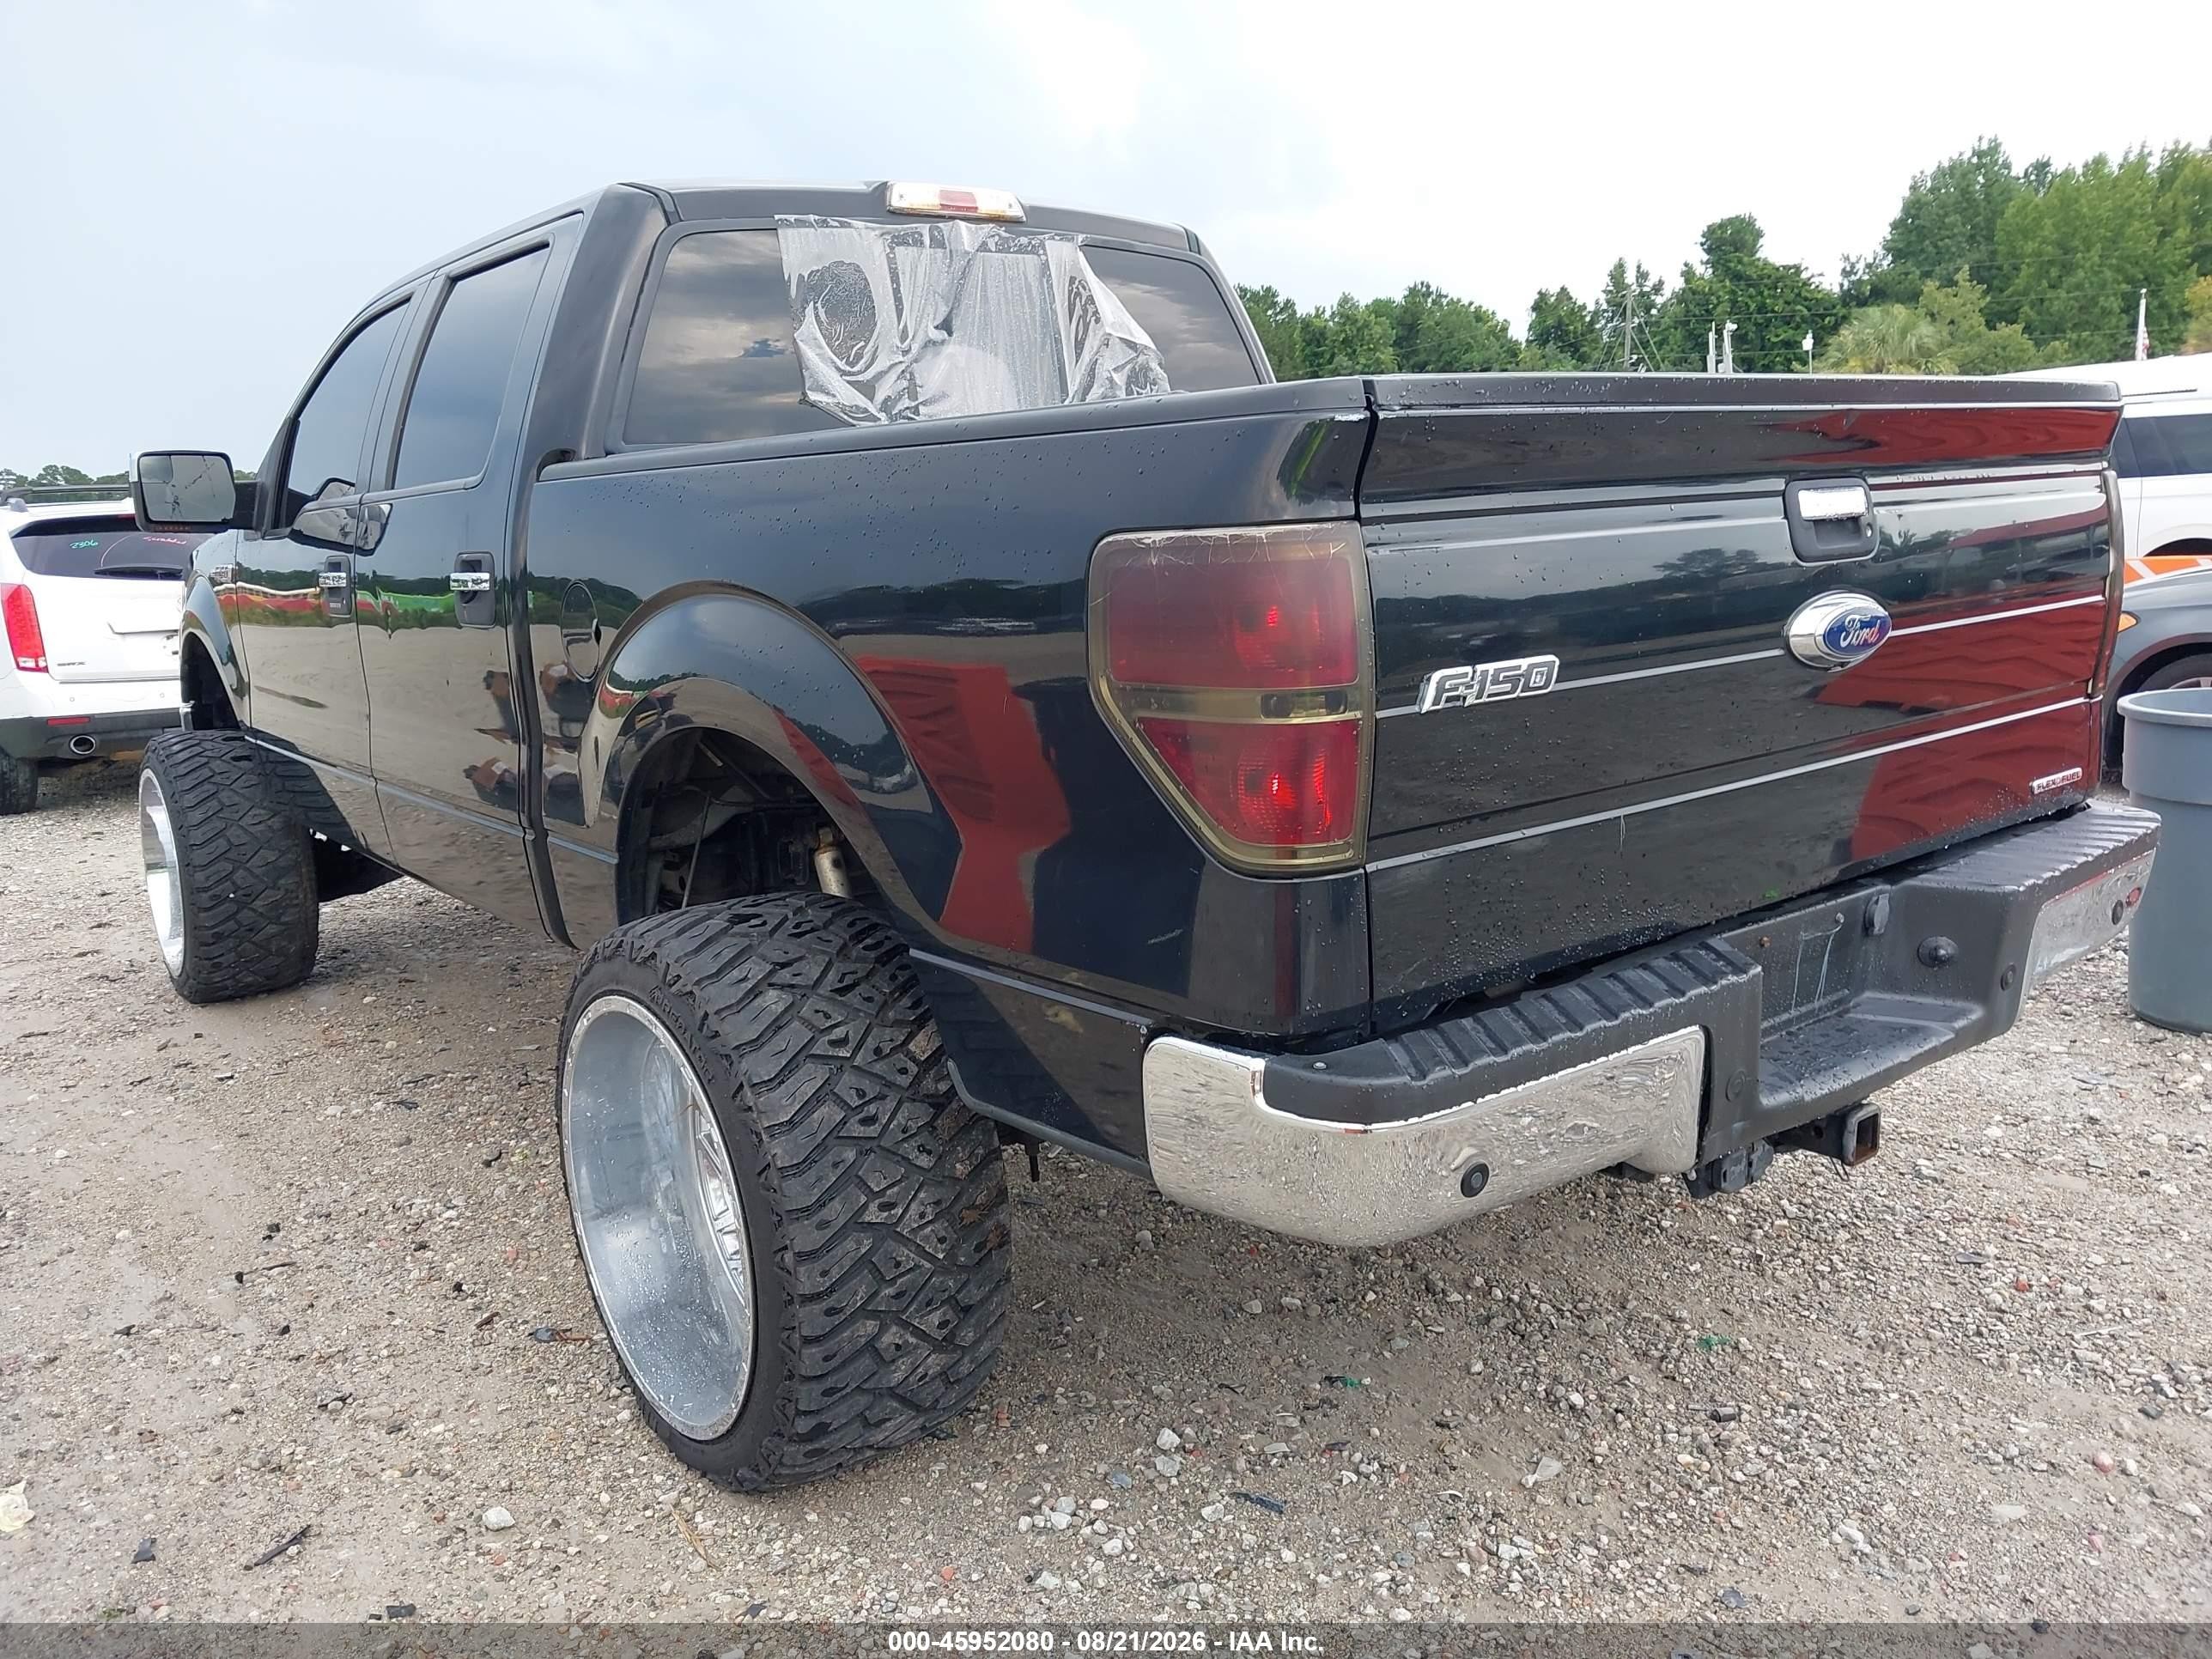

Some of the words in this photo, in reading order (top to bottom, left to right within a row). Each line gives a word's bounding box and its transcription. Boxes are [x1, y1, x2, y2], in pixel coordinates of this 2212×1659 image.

[69, 539, 99, 549] 2306
[1839, 614, 1881, 648] Ford
[1419, 655, 1560, 714] F-150
[2036, 776, 2057, 792] FLEX
[2062, 771, 2081, 784] FUEL
